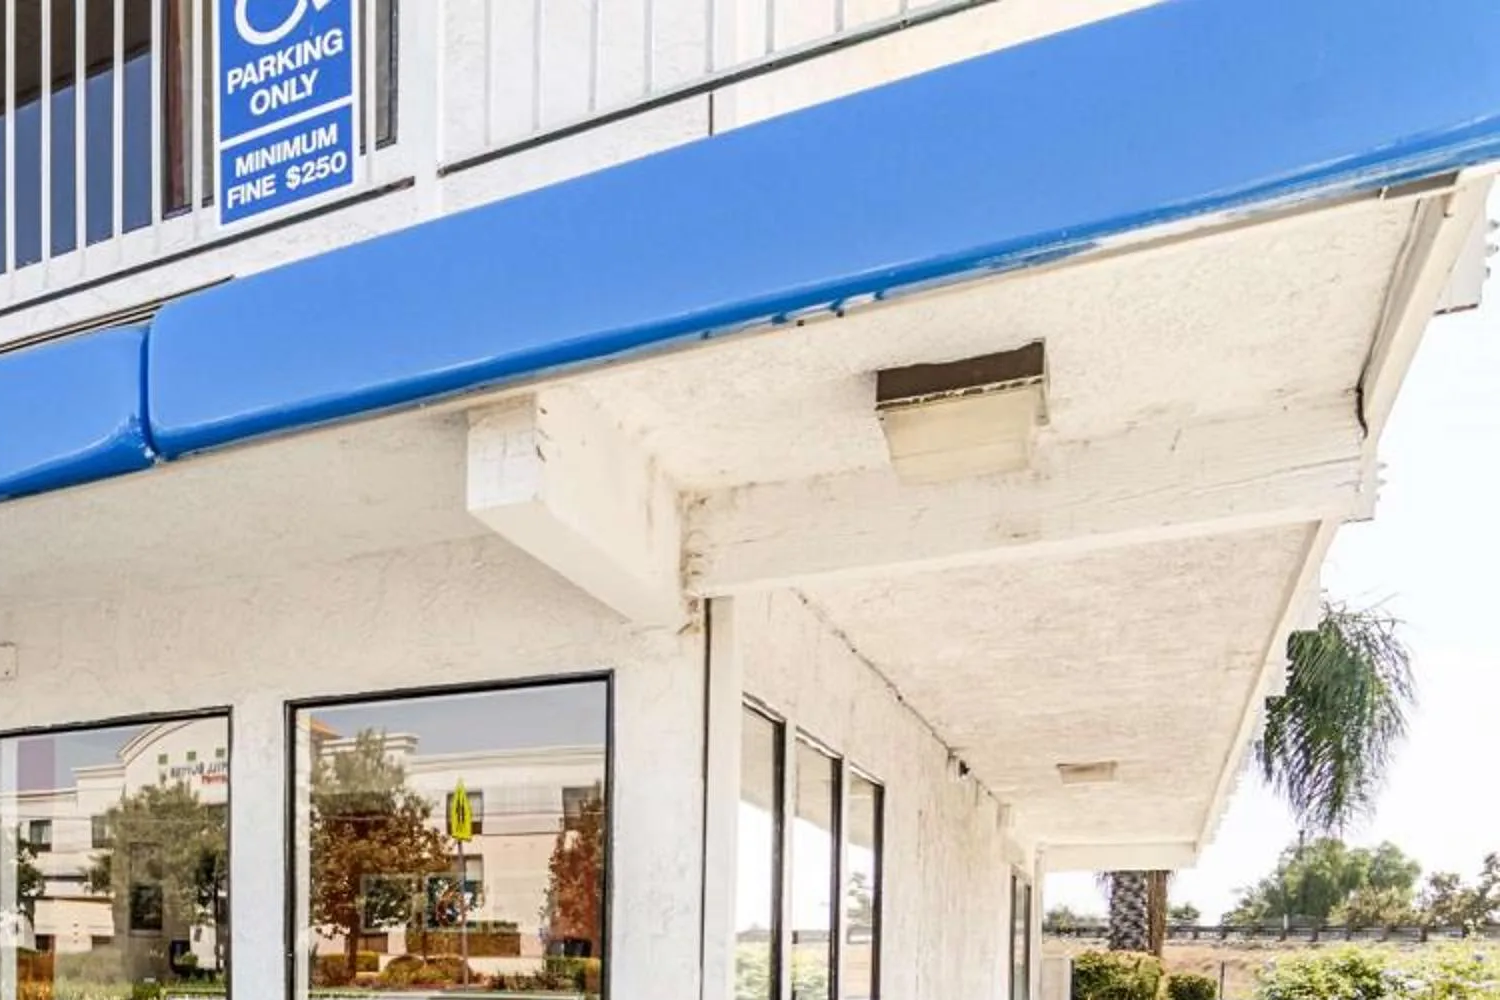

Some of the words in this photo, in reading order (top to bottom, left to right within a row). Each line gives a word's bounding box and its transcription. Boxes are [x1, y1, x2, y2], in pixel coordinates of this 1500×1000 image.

[227, 28, 344, 95] PARKING
[250, 68, 319, 116] ONLY
[235, 123, 338, 178] MINIMUM
[227, 174, 276, 209] FINE
[285, 150, 347, 190] $250
